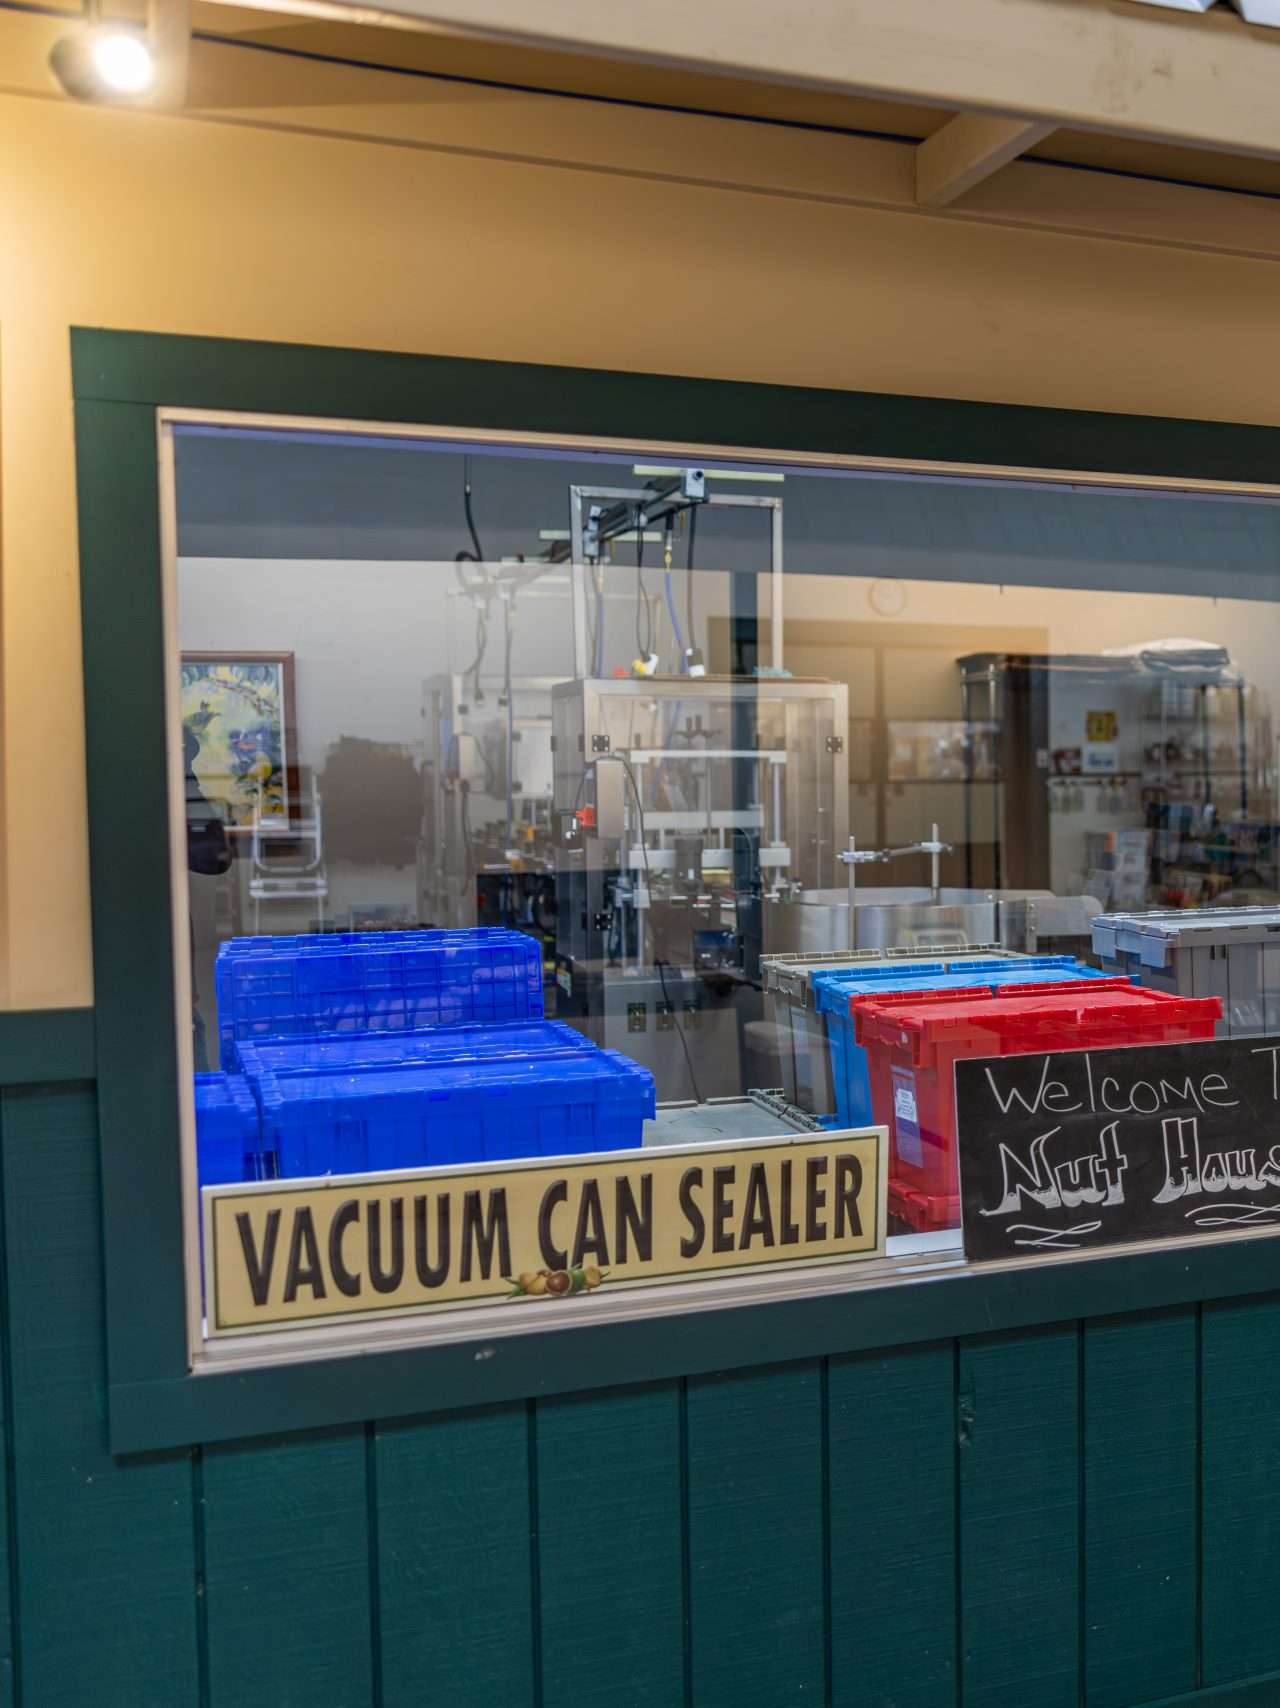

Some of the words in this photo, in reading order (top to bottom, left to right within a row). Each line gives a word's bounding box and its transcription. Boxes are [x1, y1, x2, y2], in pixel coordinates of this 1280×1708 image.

[985, 1053, 1239, 1114] Welcome
[979, 1119, 1129, 1216] Nut
[235, 1187, 513, 1306] VACUUM
[537, 1171, 653, 1271] CAN
[678, 1153, 864, 1259] SEALER
